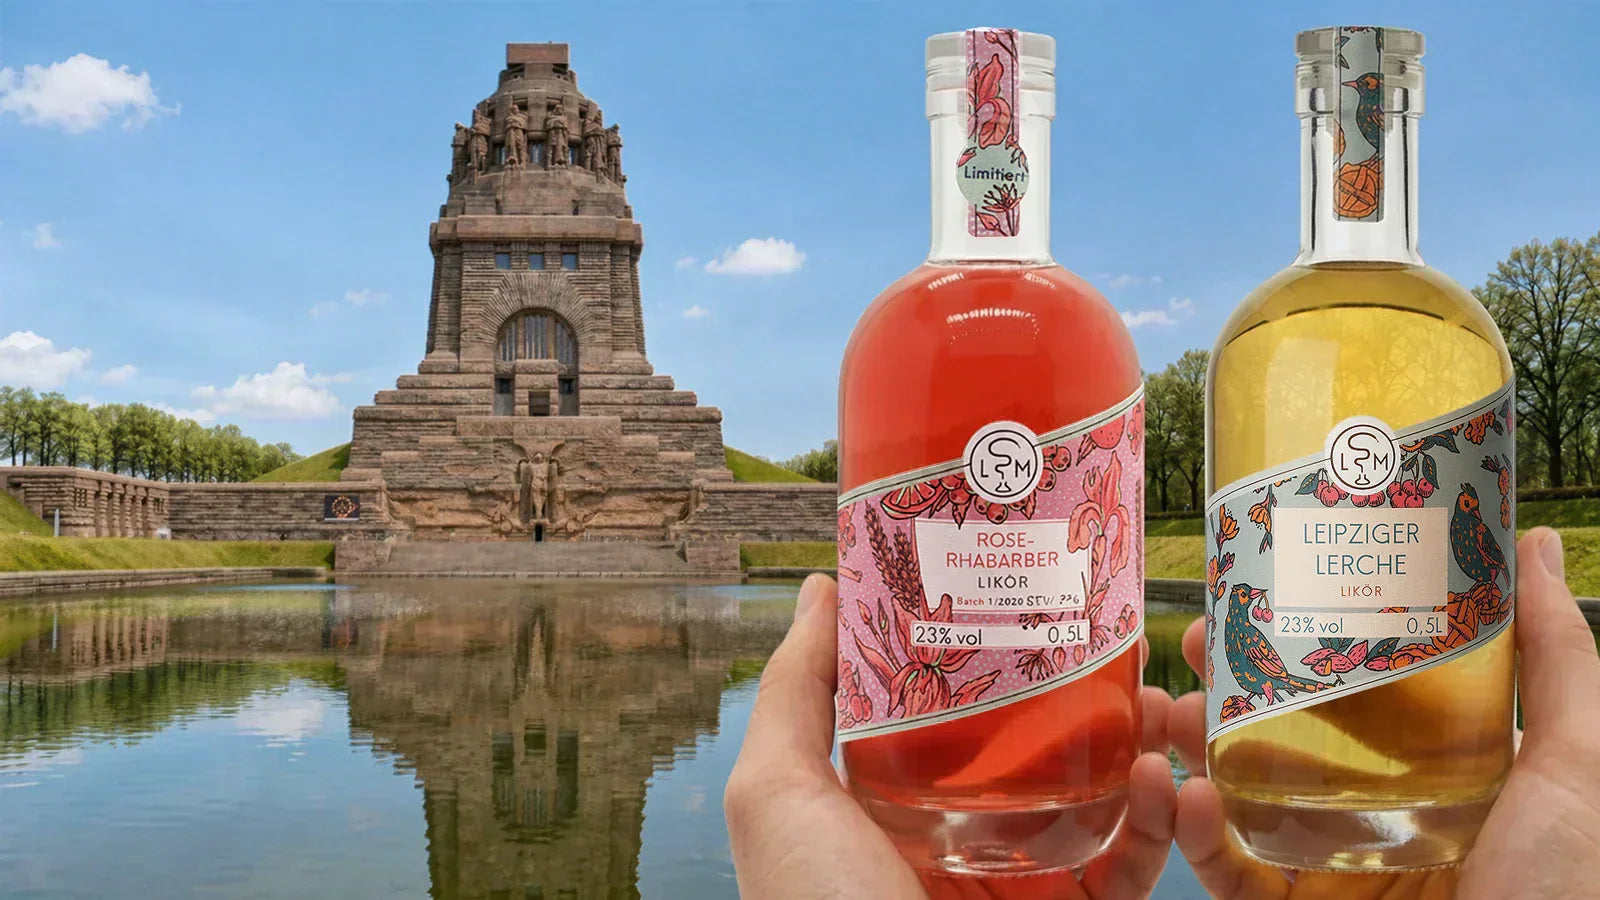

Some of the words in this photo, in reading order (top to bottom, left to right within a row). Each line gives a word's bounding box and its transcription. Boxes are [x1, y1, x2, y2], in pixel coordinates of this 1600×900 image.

[964, 166, 1026, 183] Limitiert
[977, 532, 1034, 548] ROSE-
[1303, 522, 1420, 545] LEIPZIGER
[946, 551, 1059, 569] RHABARBER
[1316, 553, 1407, 576] LERCHE
[1341, 583, 1382, 597] LIKÖR
[956, 596, 985, 606] Batch
[988, 597, 1024, 607] 1/2020
[915, 624, 952, 646] 23%
[956, 629, 982, 646] vol
[1048, 625, 1085, 645] 0,5L
[1280, 615, 1315, 634] 23%
[1319, 616, 1344, 635] vol
[1406, 616, 1443, 636] 0,5L
